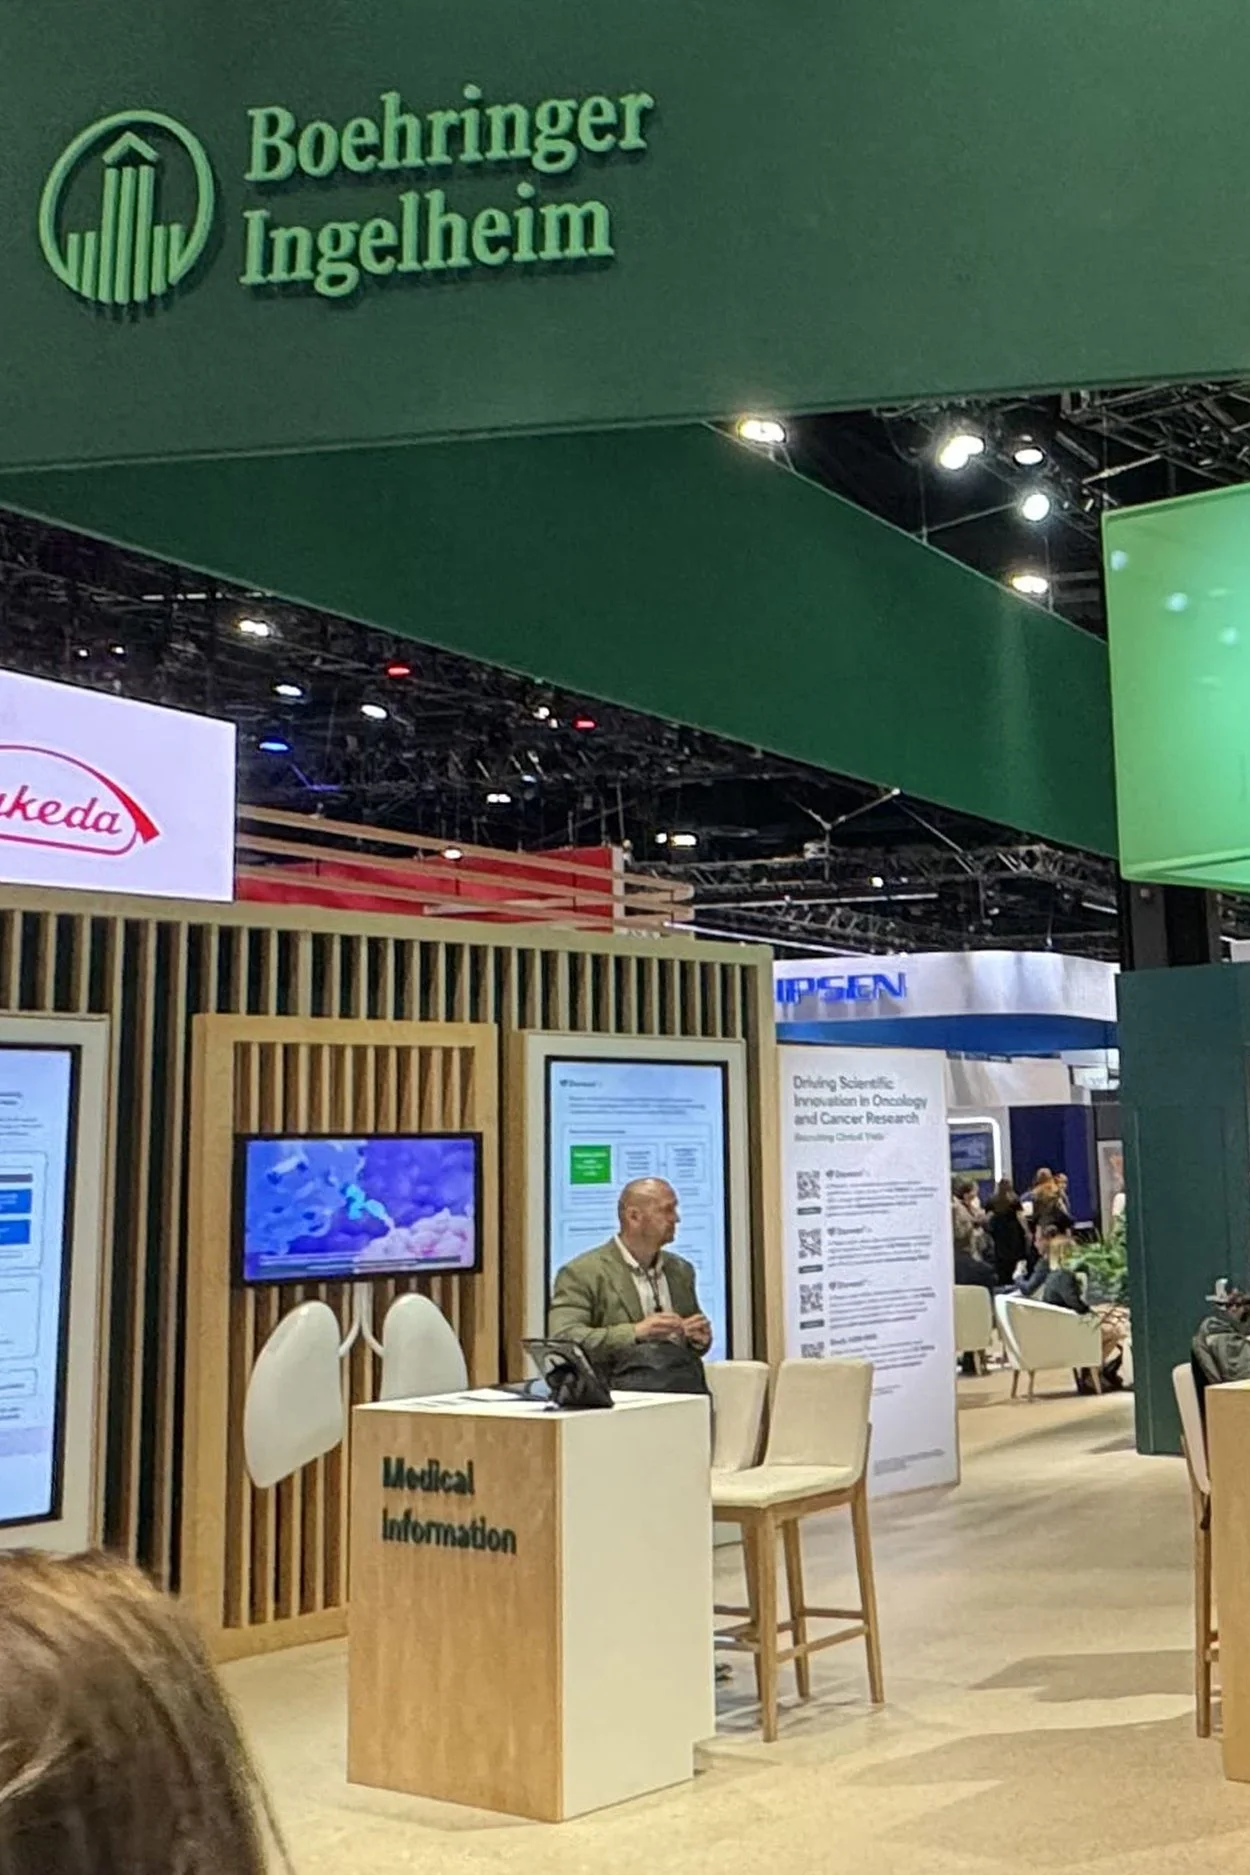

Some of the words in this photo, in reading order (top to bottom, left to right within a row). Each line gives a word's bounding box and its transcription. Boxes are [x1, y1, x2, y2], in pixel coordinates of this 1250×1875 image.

[243, 83, 654, 181] Boehringer
[239, 181, 614, 298] Ingelheim
[776, 972, 907, 1004] IPSEN
[793, 1075, 837, 1092] Driving
[839, 1075, 896, 1091] Scientific
[794, 1094, 858, 1108] Innovation
[860, 1095, 870, 1107] in
[872, 1094, 928, 1110] Oncology
[794, 1111, 818, 1125] and
[820, 1111, 864, 1125] Cancer
[866, 1111, 920, 1126] Research
[382, 1455, 475, 1496] Medical
[381, 1507, 518, 1555] Information
